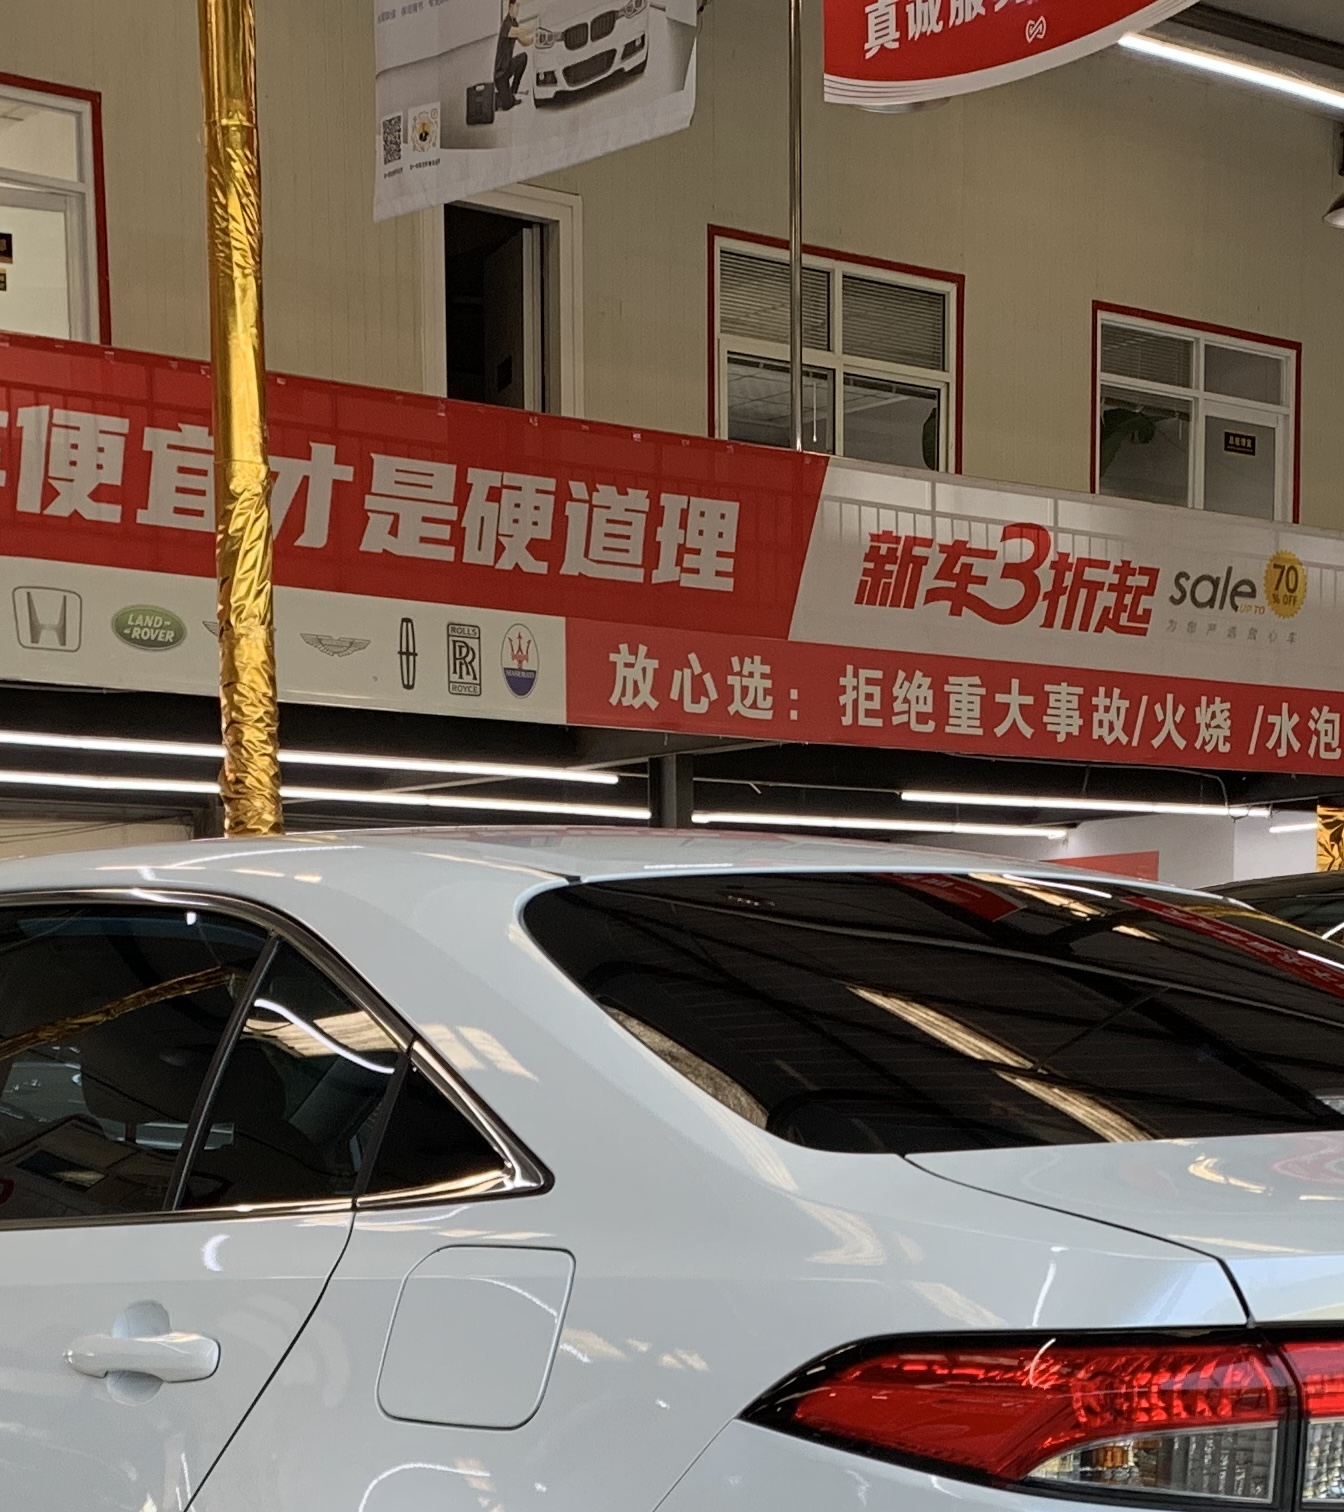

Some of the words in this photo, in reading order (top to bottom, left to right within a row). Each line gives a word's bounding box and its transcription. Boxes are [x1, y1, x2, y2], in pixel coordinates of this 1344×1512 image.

[855, 521, 1162, 638] 新车3折起
[1169, 566, 1257, 612] sale
[1273, 564, 1299, 594] 70
[450, 626, 478, 637] ROLLS
[451, 684, 479, 694] ROYCE
